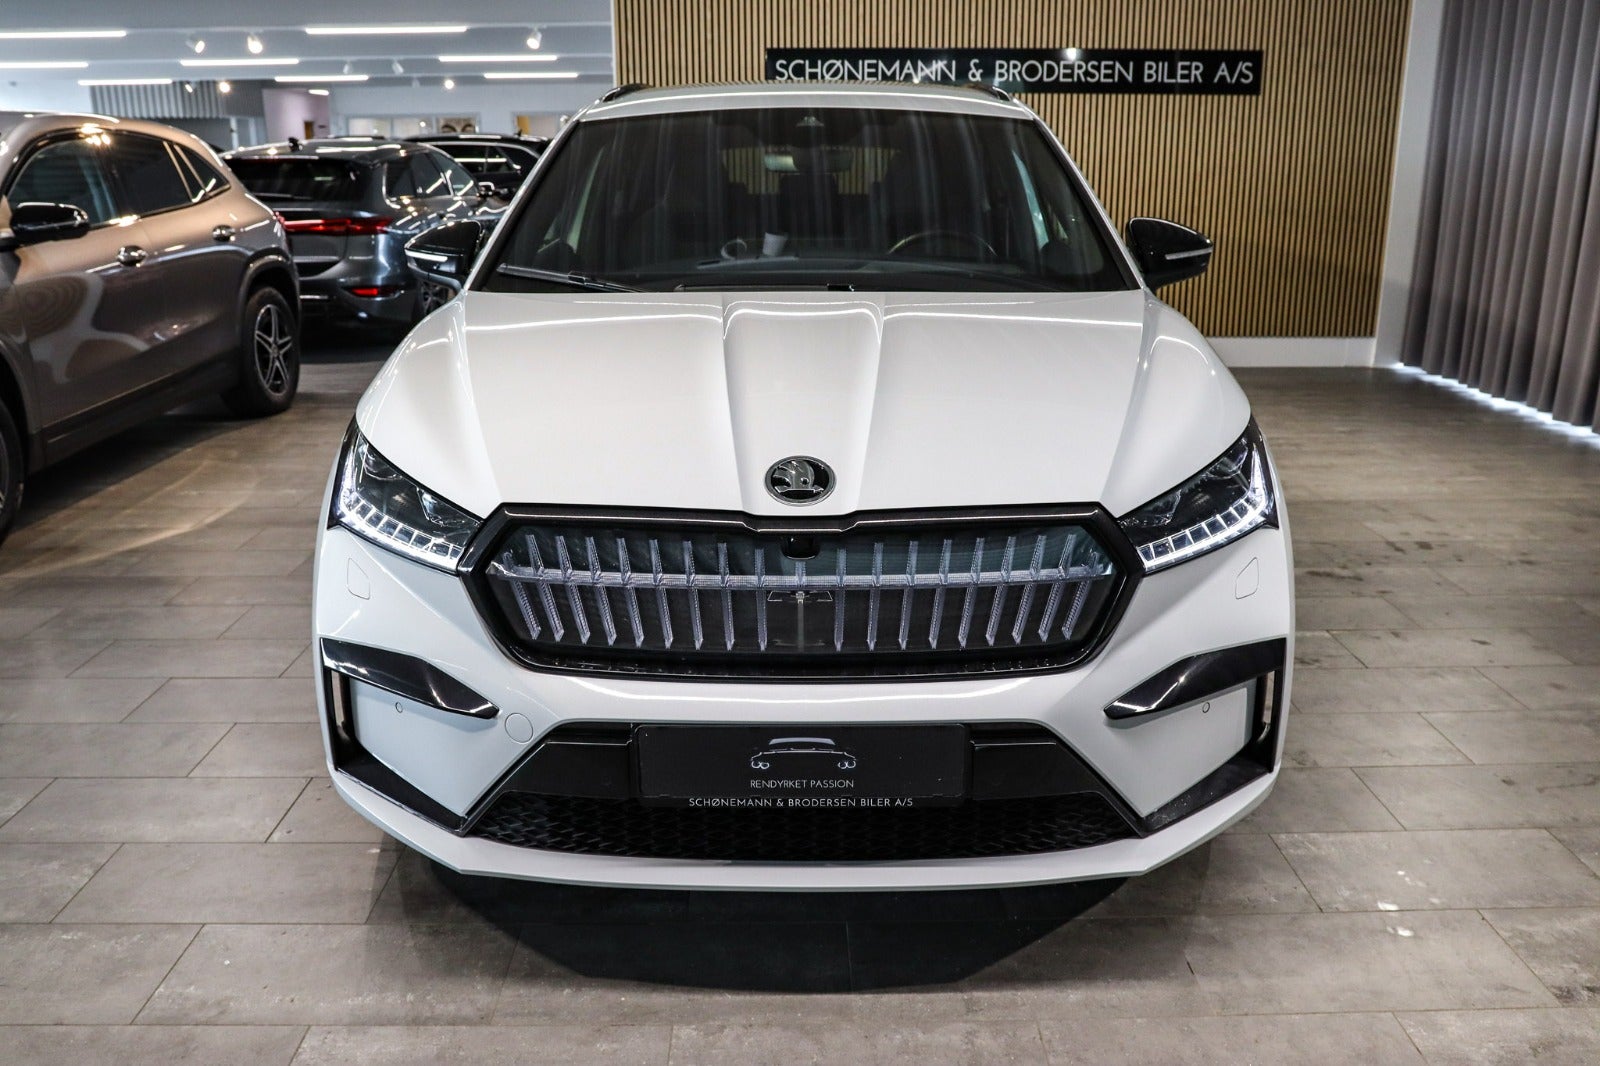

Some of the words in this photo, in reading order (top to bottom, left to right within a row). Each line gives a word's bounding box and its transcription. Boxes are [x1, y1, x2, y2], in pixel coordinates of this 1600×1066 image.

[775, 58, 956, 82] SCHØNEMANN
[968, 58, 984, 82] &
[994, 59, 1133, 83] BRODERSEN
[1143, 61, 1203, 84] BILER
[1213, 61, 1254, 84] A/S
[749, 779, 808, 789] RENDYRKET
[810, 779, 854, 789] PASSION
[688, 797, 772, 807] SCHØNEMANN
[776, 797, 785, 807] &
[788, 797, 856, 807] BRODERSEN
[860, 797, 891, 807] BILER
[894, 797, 914, 807] A/S
